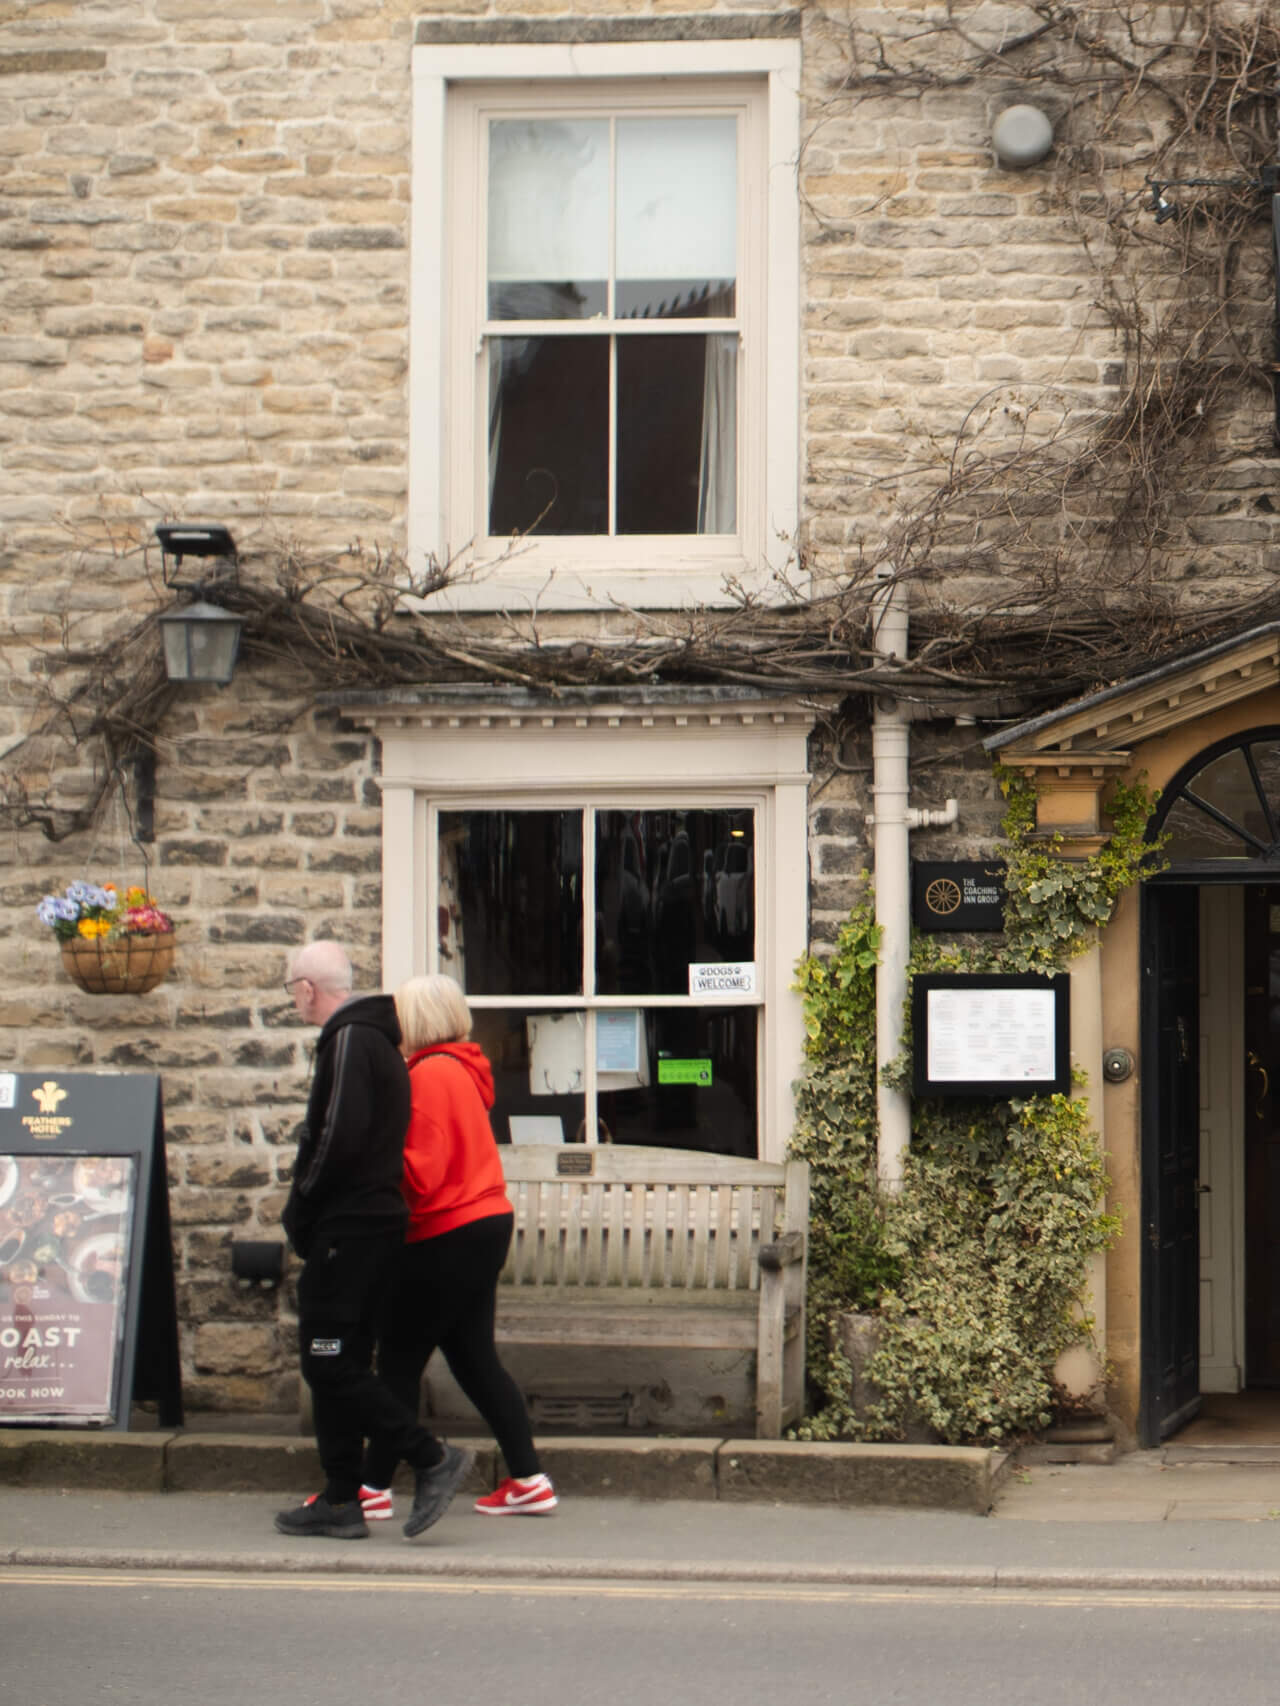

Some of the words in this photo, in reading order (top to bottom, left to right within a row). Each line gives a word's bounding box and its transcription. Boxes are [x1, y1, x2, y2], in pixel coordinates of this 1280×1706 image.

[963, 878, 976, 887] THE
[963, 886, 998, 895] COACHING
[963, 895, 976, 904] INN
[977, 895, 1000, 904] GROUP
[706, 967, 733, 976] DOGS
[697, 978, 746, 990] WELCOME
[22, 1116, 72, 1126] FEATHERS
[30, 1125, 62, 1134] HOTEL
[31, 1387, 64, 1398] NOW
